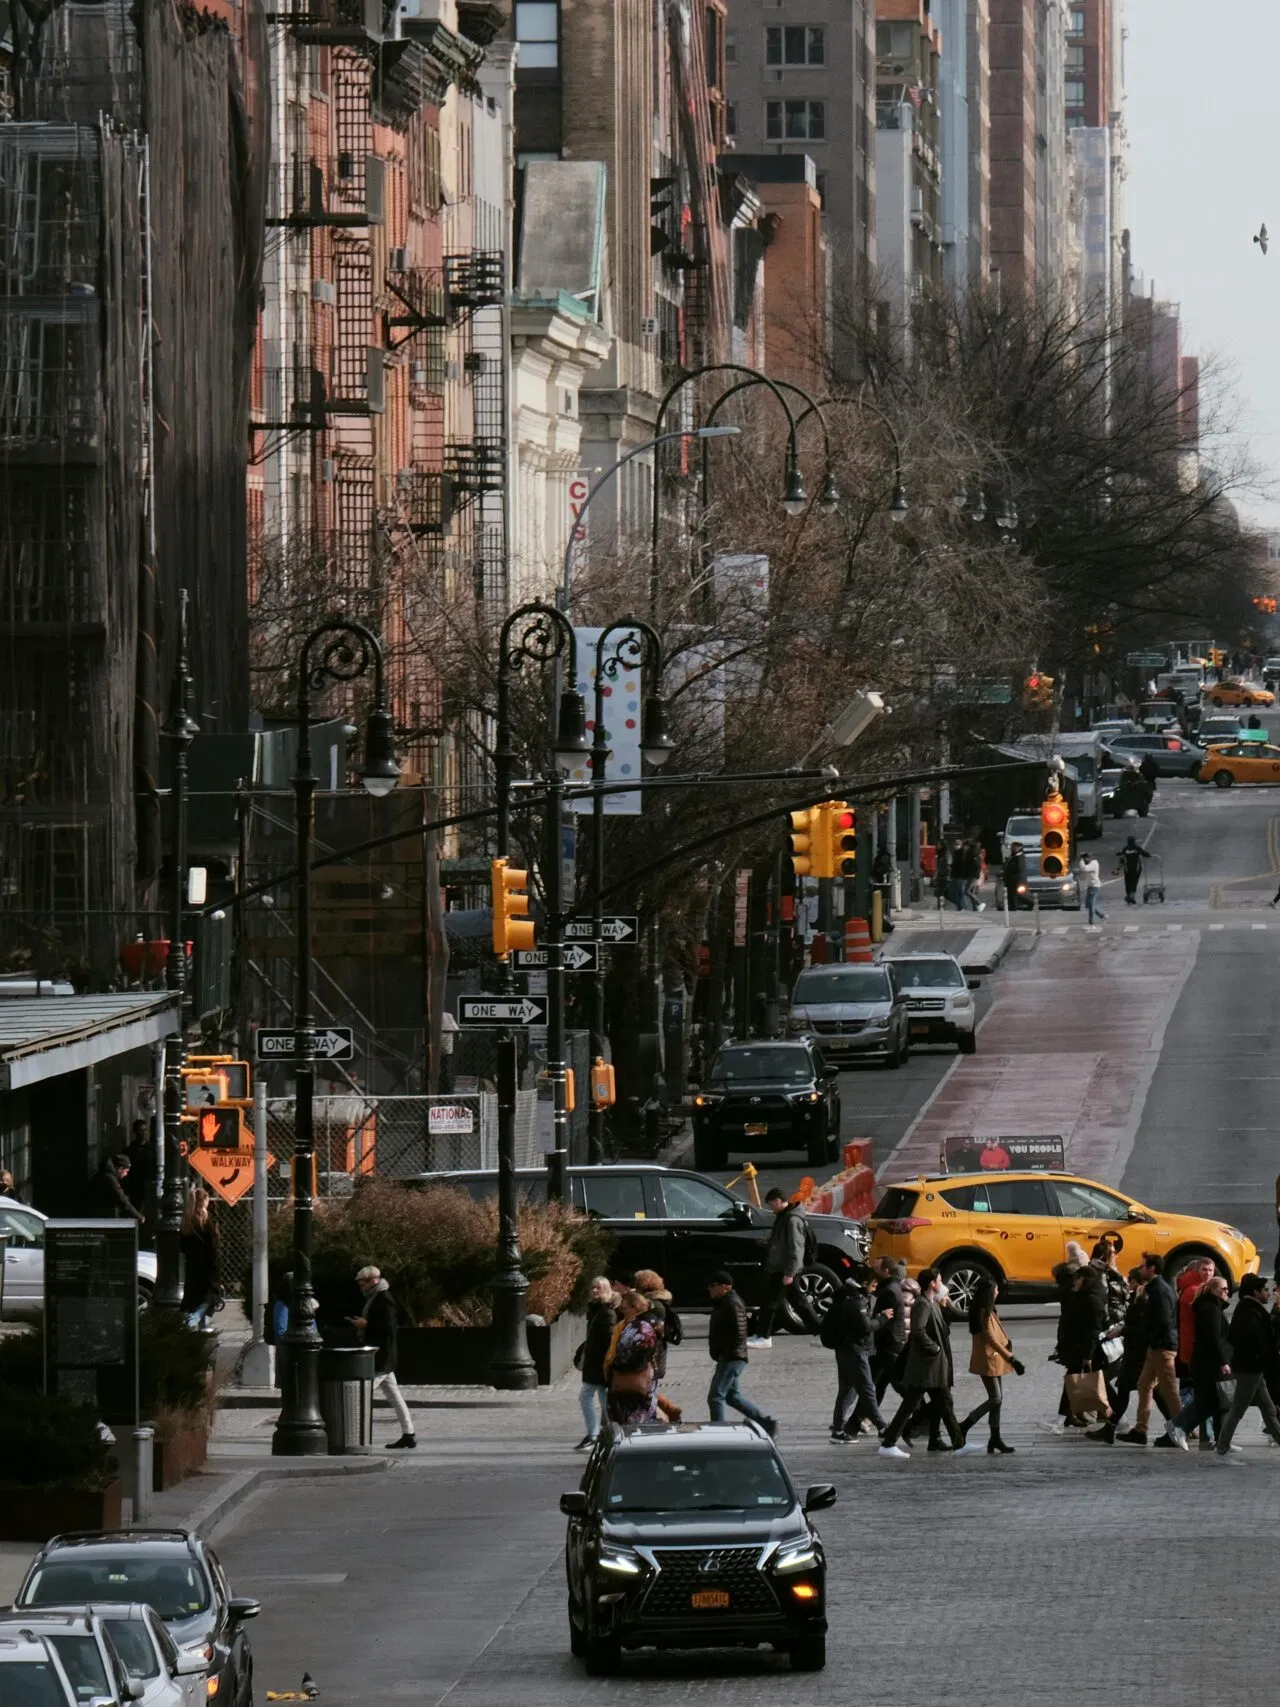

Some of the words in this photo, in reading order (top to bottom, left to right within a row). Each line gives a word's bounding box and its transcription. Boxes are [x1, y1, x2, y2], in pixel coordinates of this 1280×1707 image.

[571, 924, 593, 935] ONE
[603, 924, 625, 935] WAY
[525, 952, 549, 963] ONE
[472, 1005, 497, 1017] ONE
[508, 1005, 534, 1017] WAY
[266, 1038, 293, 1050] ONE
[1009, 1144, 1027, 1154] YOU
[1029, 1144, 1062, 1154] PEOPLE
[211, 1156, 251, 1167] WALKWAY
